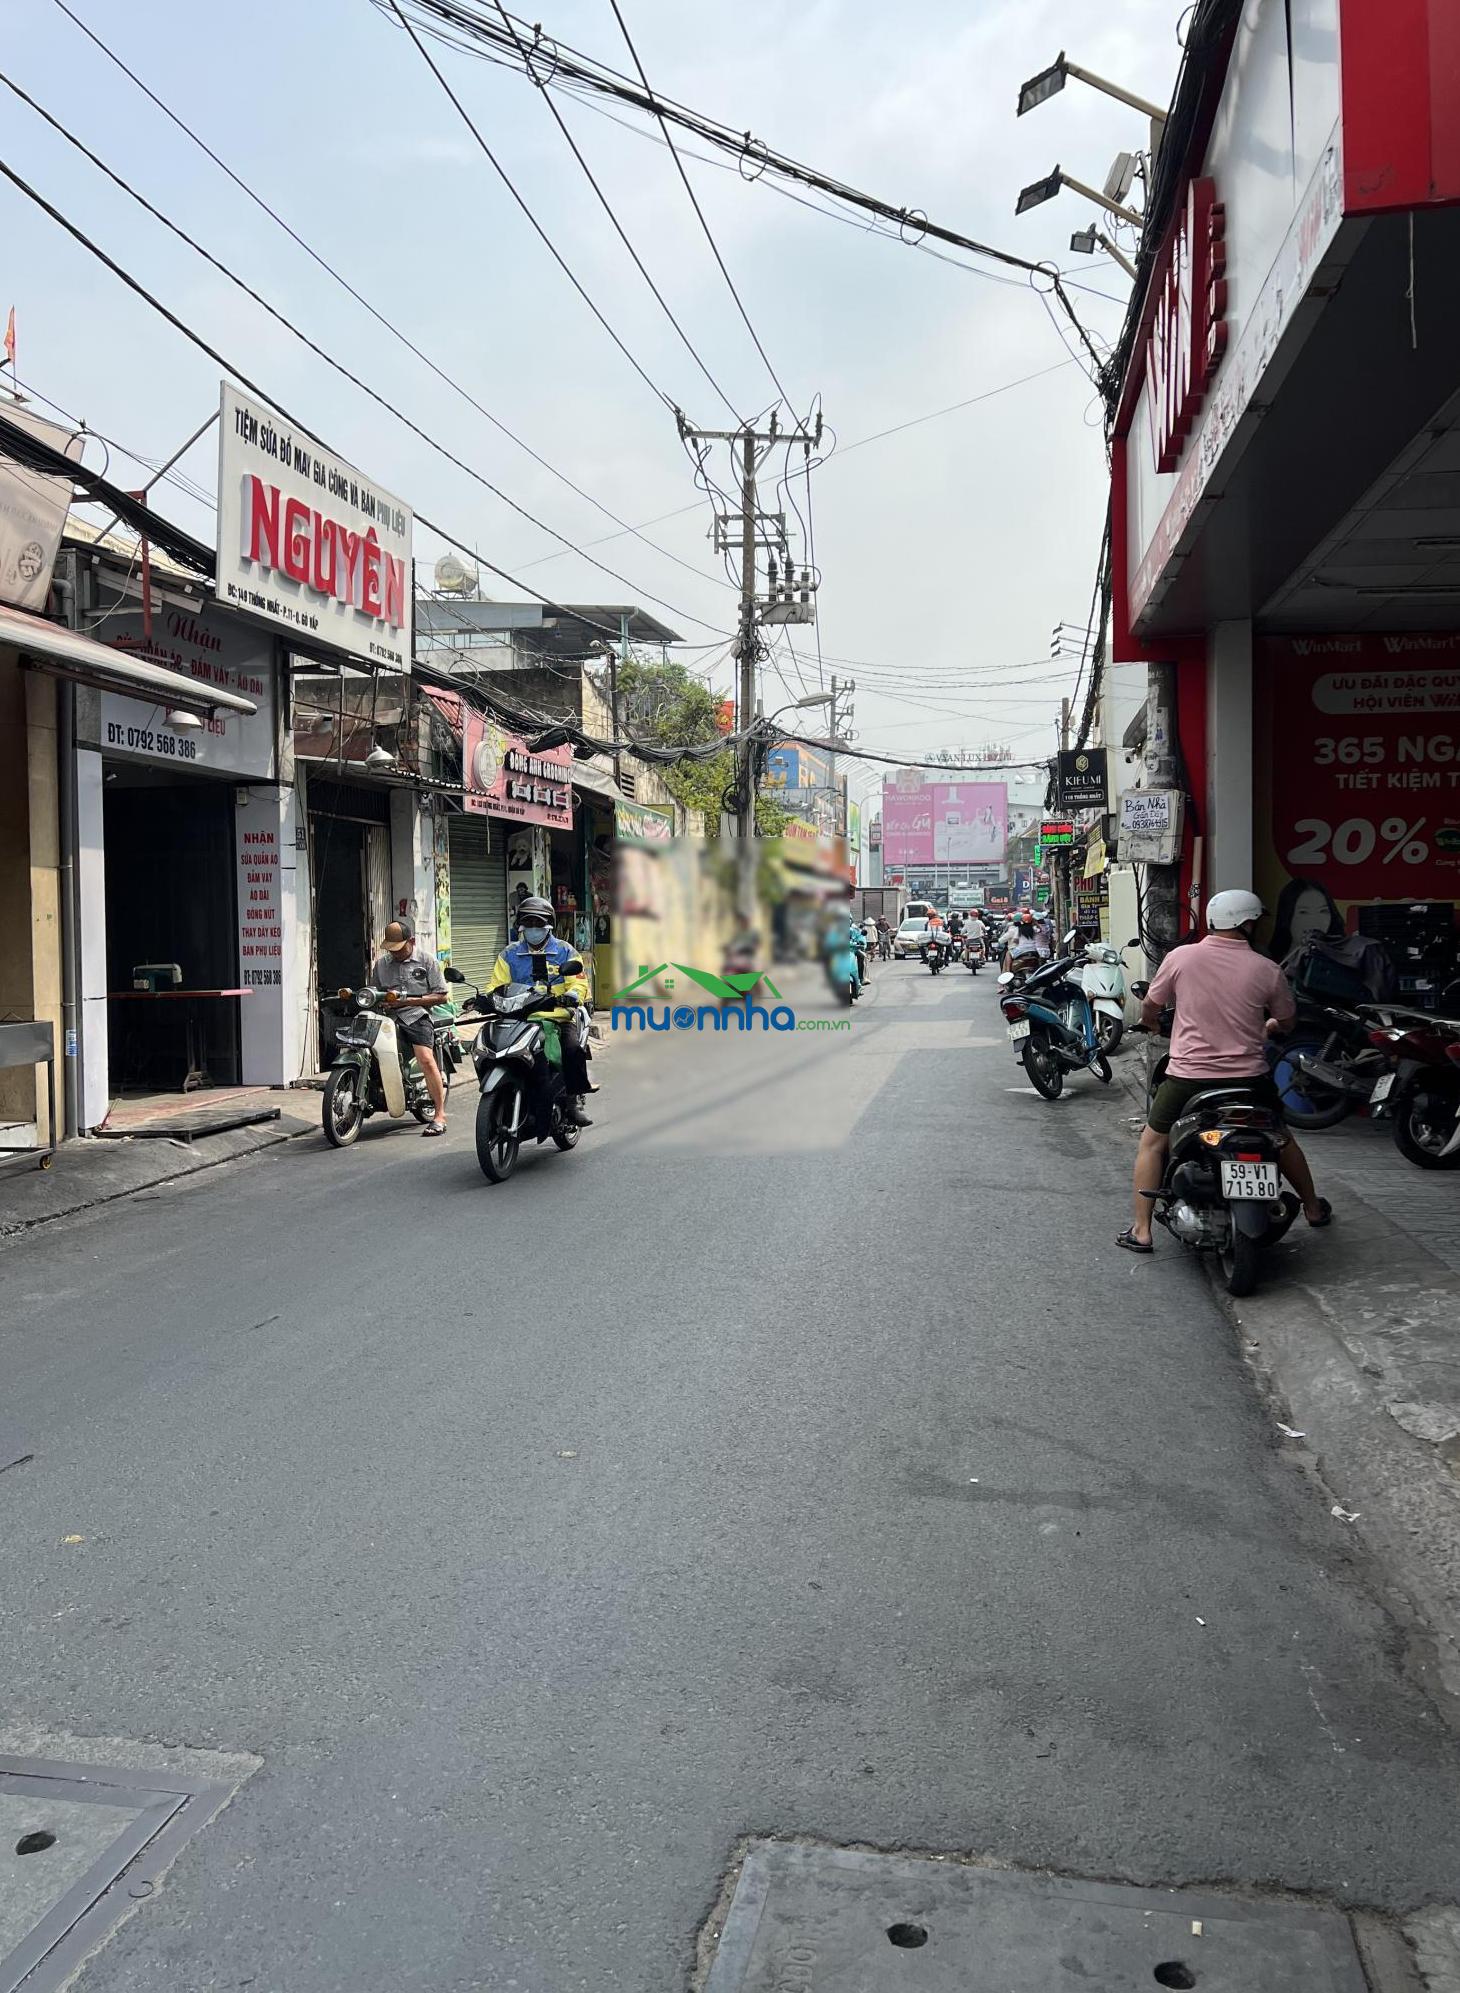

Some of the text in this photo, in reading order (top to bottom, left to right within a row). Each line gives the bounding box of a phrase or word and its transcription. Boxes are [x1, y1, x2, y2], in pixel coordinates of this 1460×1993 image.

[235, 407, 258, 446] TIỆM
[260, 421, 278, 459] SỬA
[294, 447, 312, 478] MAY
[313, 459, 326, 489] GIA
[328, 468, 349, 502] CÔNG
[350, 481, 359, 510] VÀ
[361, 489, 376, 518] BÁN
[377, 500, 391, 532] PHỤ
[392, 509, 406, 538] LIỆU
[242, 473, 406, 630] NGUYÊN
[248, 591, 266, 610] THỐNG
[1292, 639, 1361, 655] WinMart
[1360, 675, 1388, 689] ĐÃI
[1394, 674, 1427, 692] ĐẶC
[1353, 696, 1382, 712] HỘI
[1387, 693, 1425, 708] VIÊN
[108, 723, 196, 758] ĐT: 0792 568 386
[1313, 736, 1385, 765] 365
[1336, 769, 1381, 789] TIẾT
[1388, 769, 1440, 791] KIỆM
[1125, 796, 1166, 812] Bán Nhà
[244, 831, 274, 846] NHẬN
[1287, 816, 1429, 865] 20%
[242, 927, 256, 937] THAY
[1230, 1164, 1268, 1180] 59-V1
[1226, 1180, 1275, 1197] 715.80
